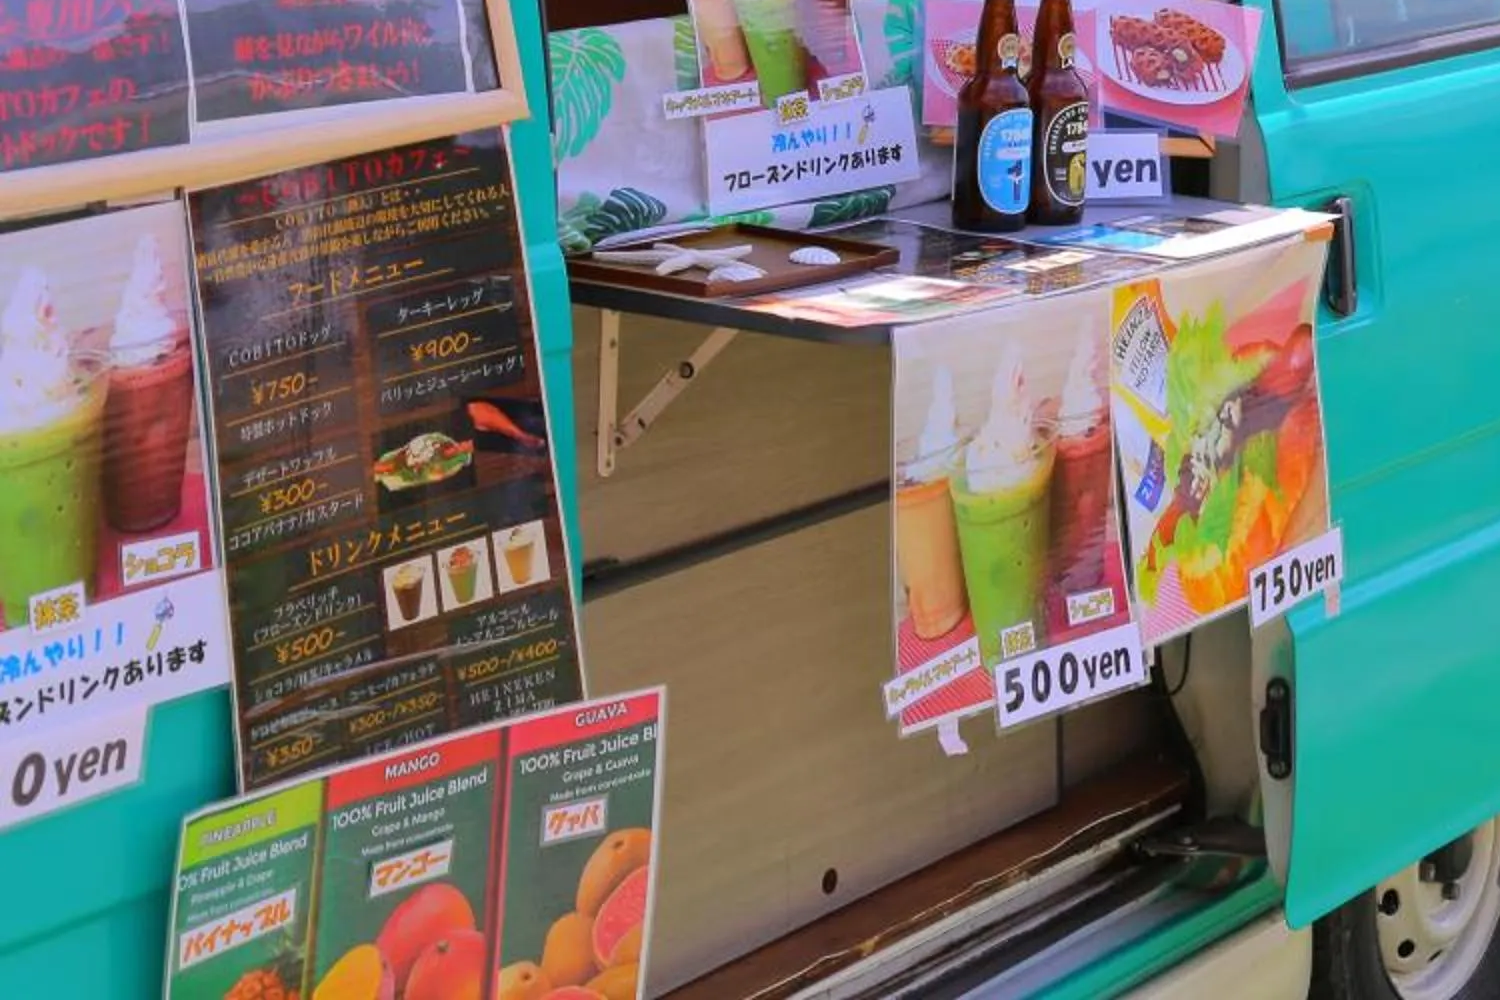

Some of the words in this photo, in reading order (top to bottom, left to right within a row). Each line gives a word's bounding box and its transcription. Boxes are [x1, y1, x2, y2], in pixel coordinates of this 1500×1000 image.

[723, 144, 902, 192] フローズンドリンクあります
[287, 257, 426, 306] フードメニュー
[397, 288, 485, 322] ターキーレッグ
[308, 512, 467, 577] ドリンクメニュー
[1254, 550, 1336, 613] 750yen
[1003, 645, 1131, 715] 500yen
[575, 702, 628, 729] GUAVA
[384, 751, 441, 781] MANGO
[562, 739, 596, 767] Fruit
[598, 731, 637, 760] Juice
[374, 795, 406, 819] Fruit
[407, 787, 446, 811] Juice
[447, 768, 488, 800] Blend
[269, 834, 308, 861] Blend
